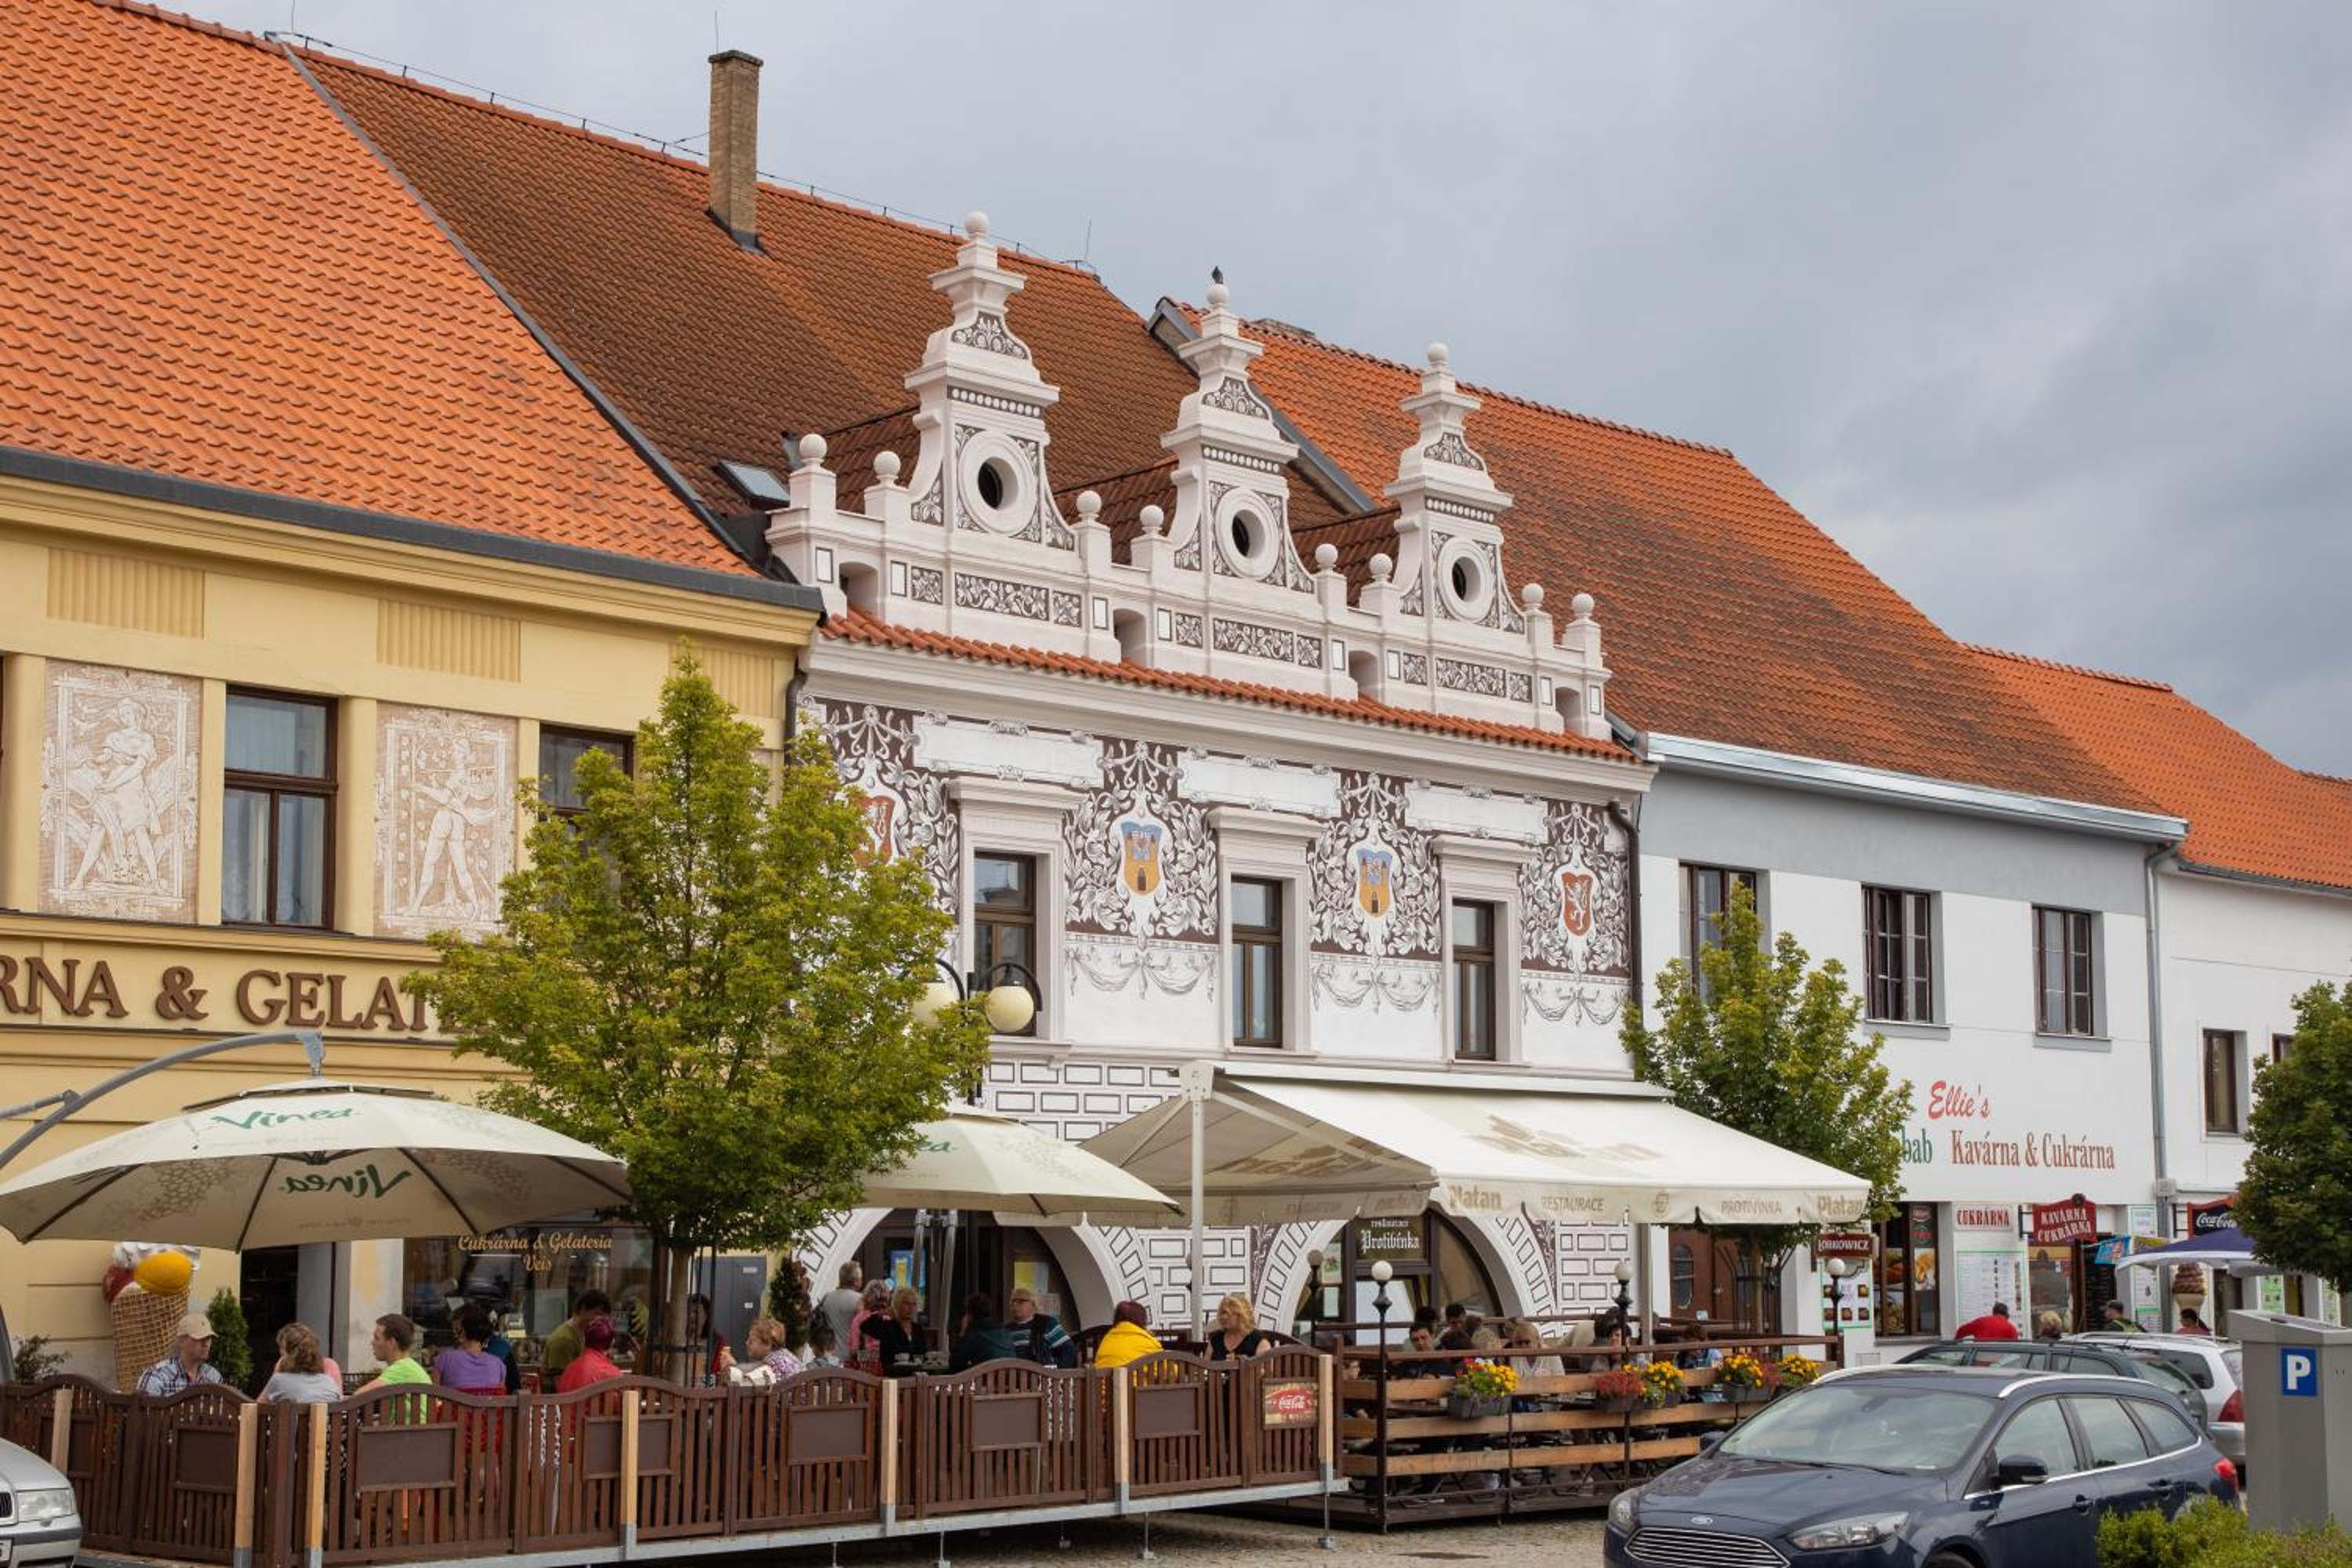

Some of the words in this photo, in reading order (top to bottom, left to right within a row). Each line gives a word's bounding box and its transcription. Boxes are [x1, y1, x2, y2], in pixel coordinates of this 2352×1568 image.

[154, 966, 209, 1021] &
[211, 1109, 352, 1129] Vinea
[1928, 1080, 1991, 1120] Ellie's
[1951, 1129, 2020, 1167] Kavárna
[2025, 1132, 2039, 1167] &
[2042, 1134, 2115, 1169] Cukrárna
[1448, 1184, 1501, 1210] Platan
[2287, 1354, 2310, 1390] P
